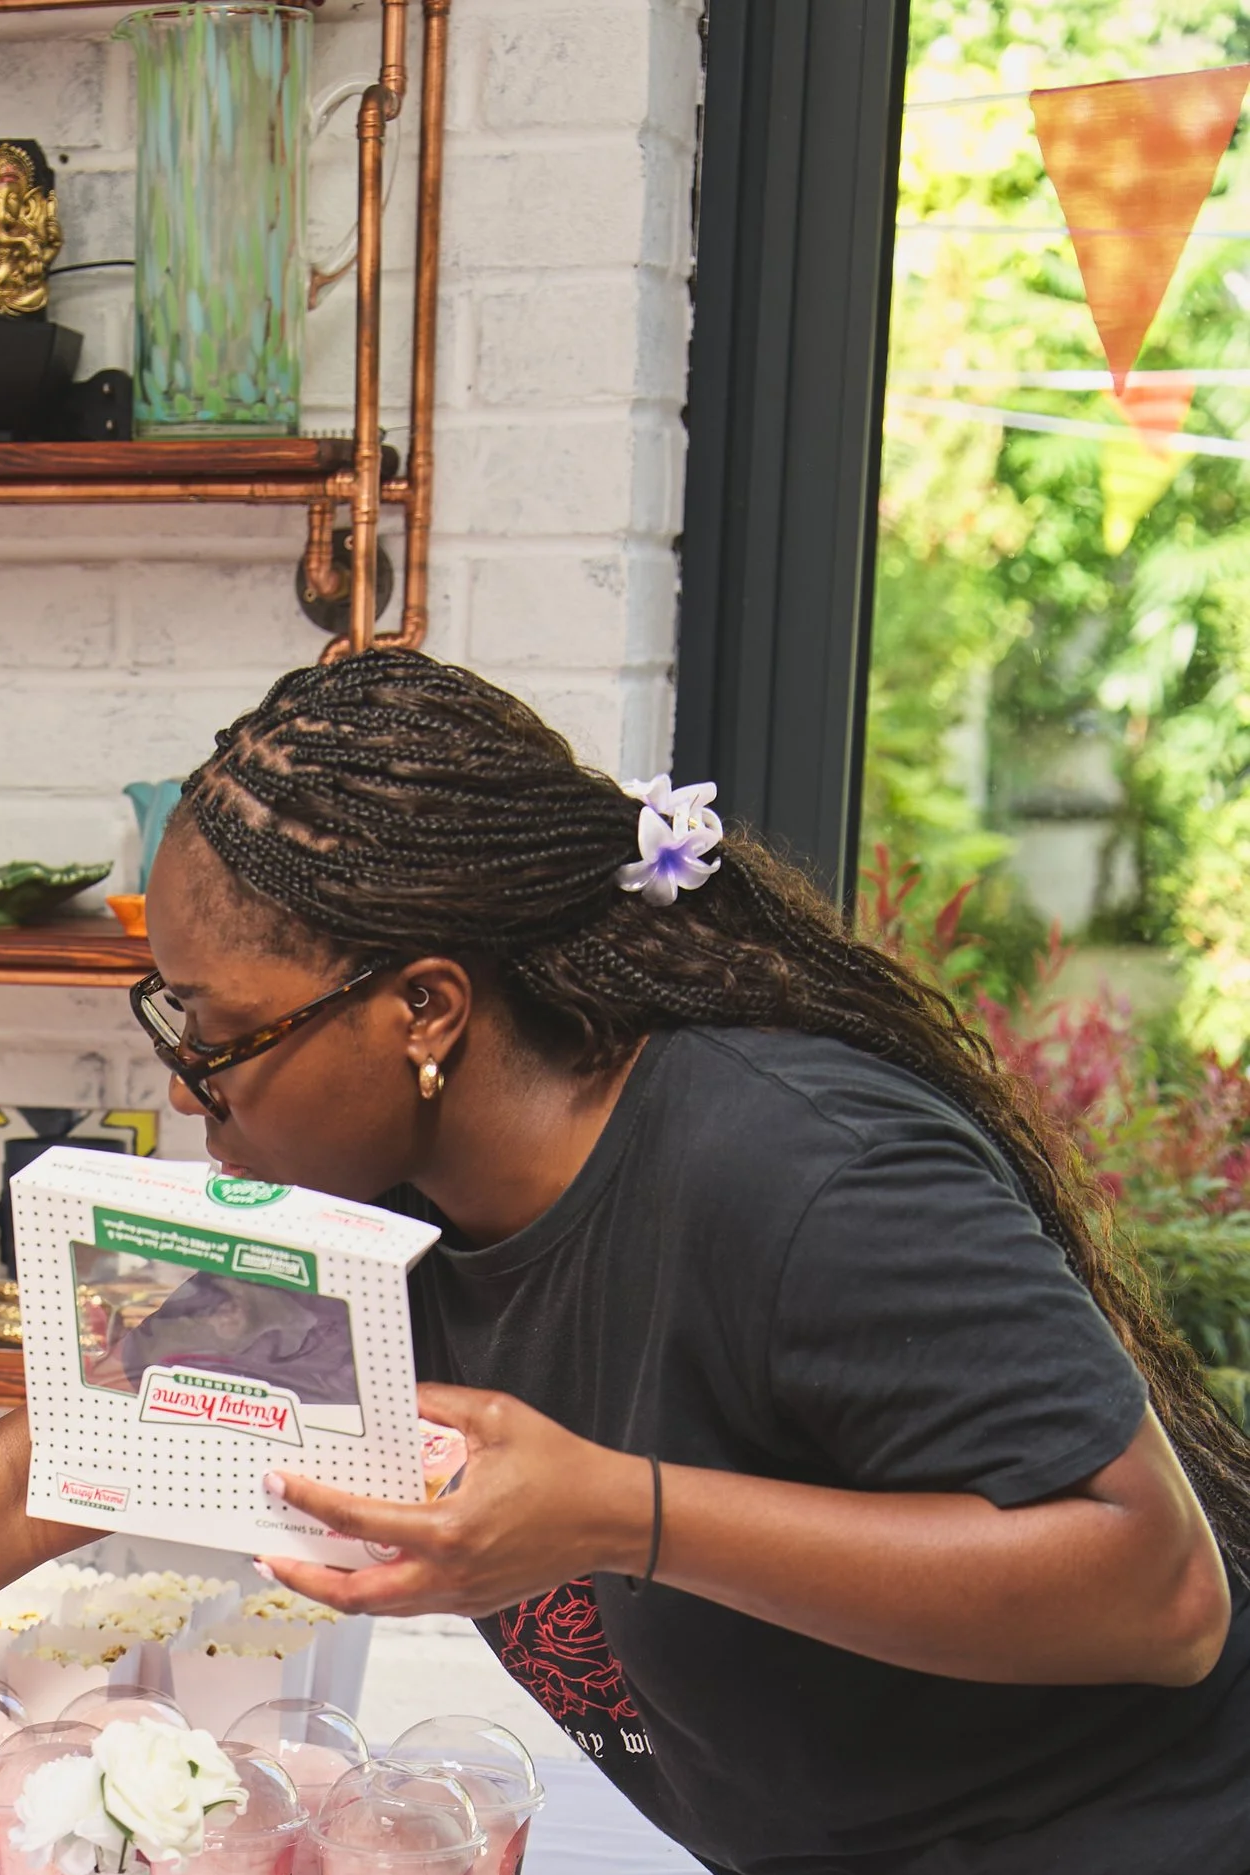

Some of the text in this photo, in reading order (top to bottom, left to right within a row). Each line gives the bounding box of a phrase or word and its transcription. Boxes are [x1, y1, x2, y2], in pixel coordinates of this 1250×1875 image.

[150, 1387, 288, 1431] Krispy Kreme
[255, 1519, 307, 1534] CONTAINS
[309, 1527, 324, 1537] SIX
[620, 1727, 656, 1755] wi
